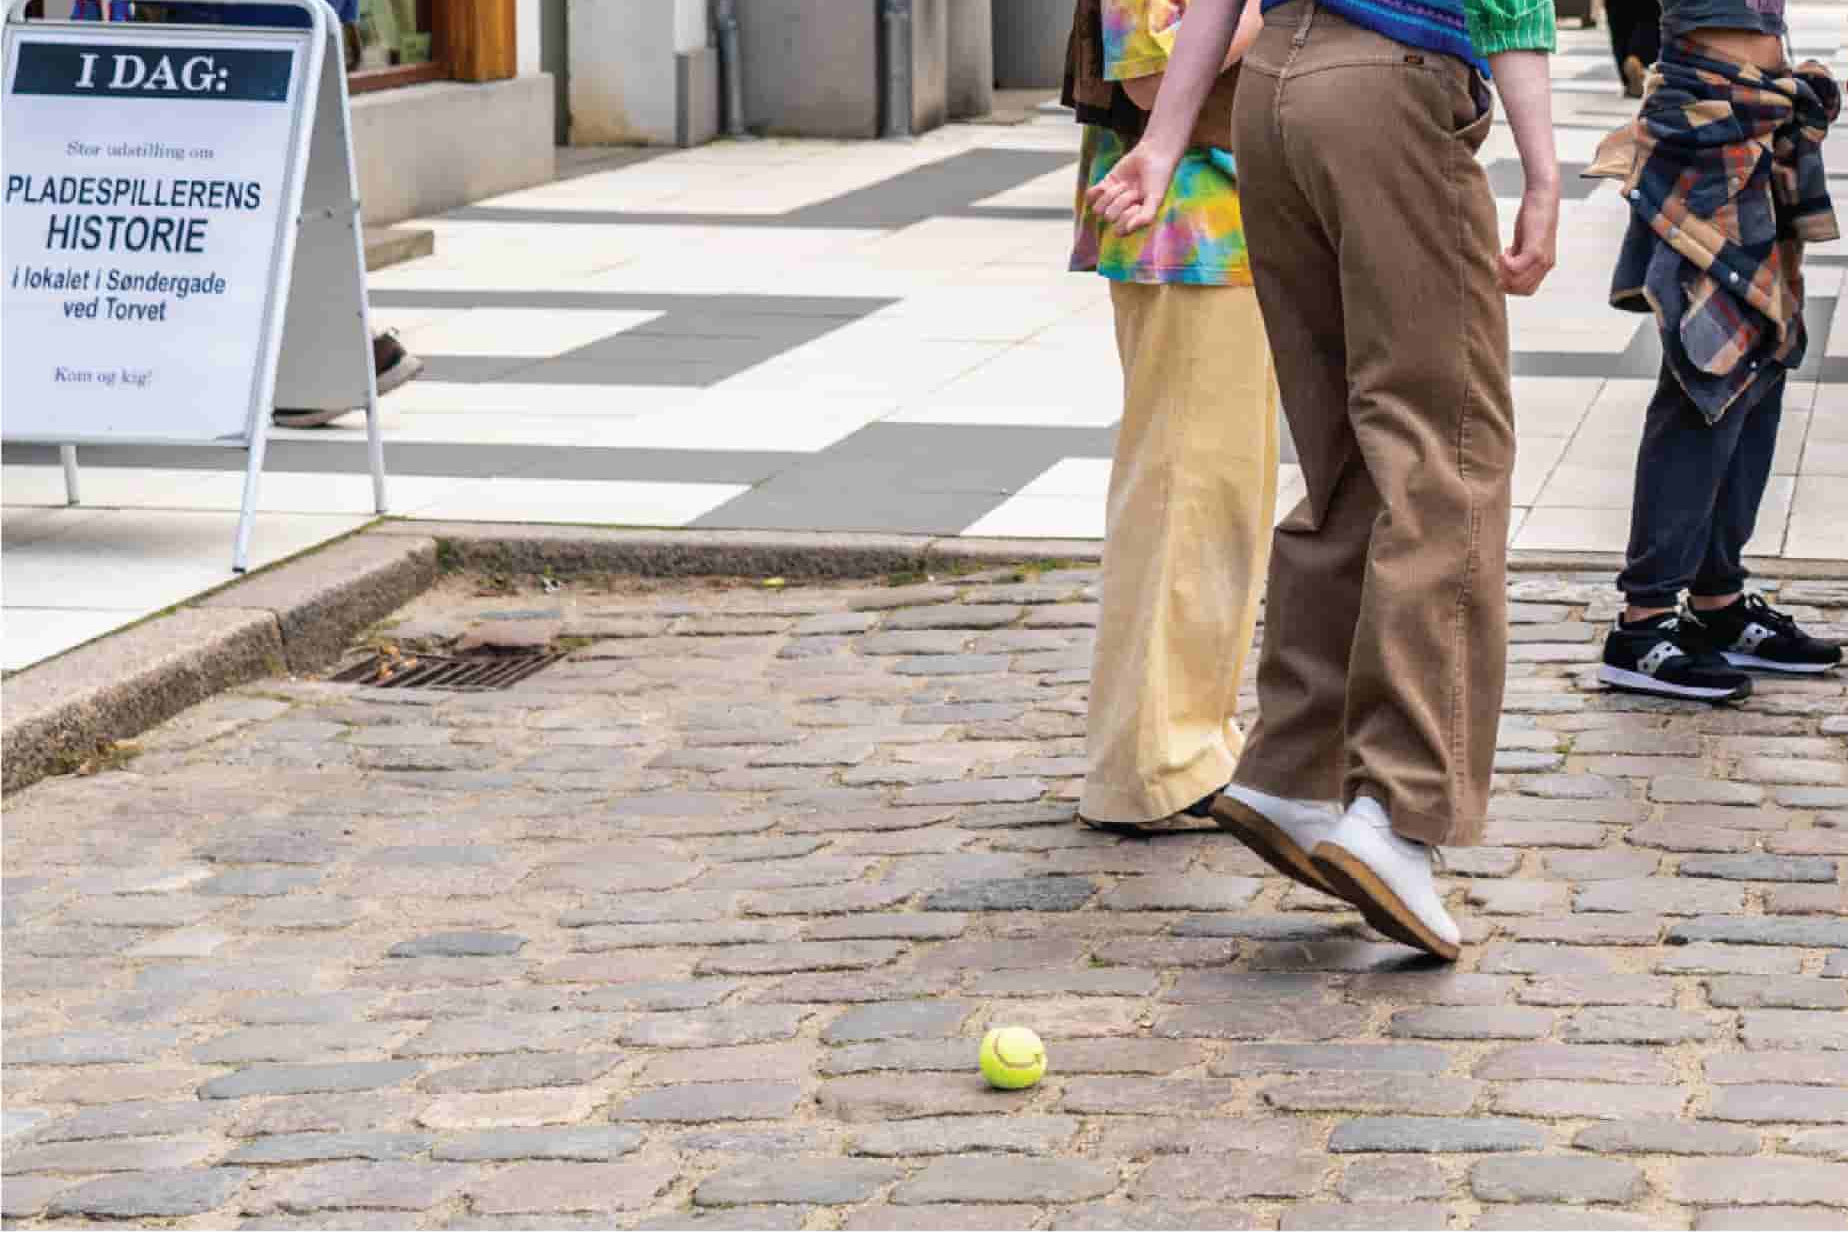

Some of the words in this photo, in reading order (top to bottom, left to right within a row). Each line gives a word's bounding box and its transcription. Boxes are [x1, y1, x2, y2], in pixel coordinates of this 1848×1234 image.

[75, 53, 100, 88] I
[107, 54, 229, 93] DAG:
[65, 140, 101, 158] Stor
[106, 142, 185, 160] udstilling
[189, 147, 214, 159] om
[5, 174, 262, 210] PLADESPILLERENS
[45, 214, 210, 254] HISTORIE
[24, 267, 91, 291] lokalet
[106, 269, 227, 298] Søndergade
[63, 299, 98, 319] ved
[105, 298, 168, 322] Torvet
[55, 366, 93, 383] Kom
[97, 372, 116, 388] og
